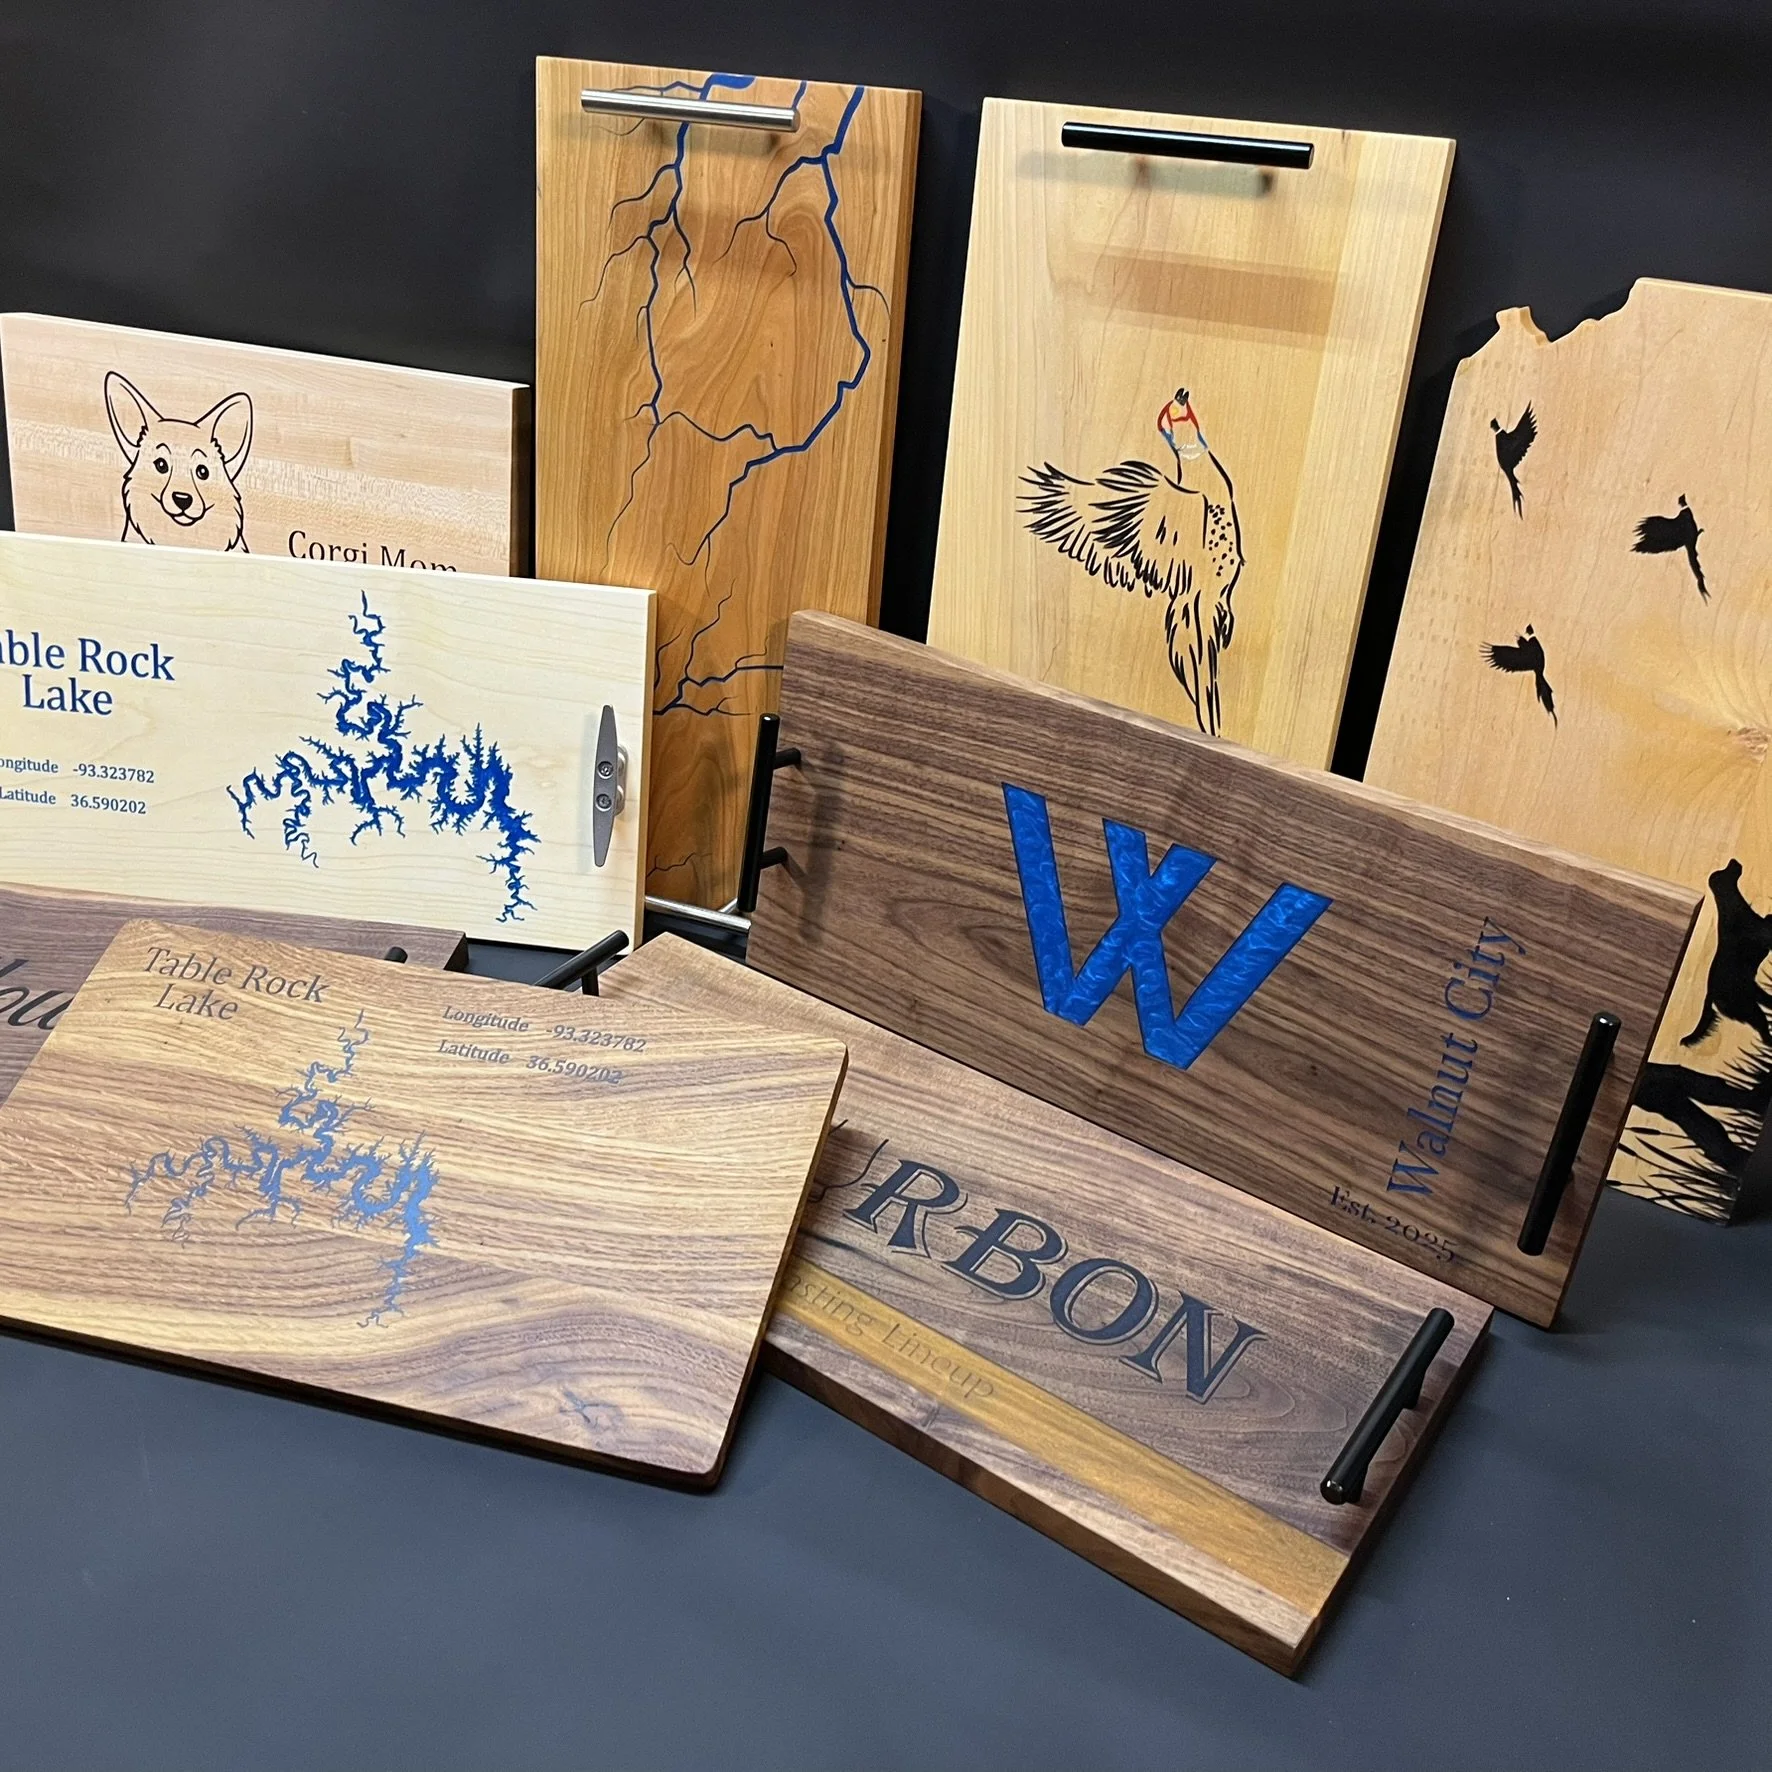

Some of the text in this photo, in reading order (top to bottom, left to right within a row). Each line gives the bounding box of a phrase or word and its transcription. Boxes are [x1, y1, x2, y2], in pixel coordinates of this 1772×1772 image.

[0, 629, 176, 681] ble Rock
[21, 673, 113, 716] Lake
[72, 764, 155, 784] -93.323782
[0, 786, 147, 815] Latitude 36.590202
[1002, 782, 1333, 1071] W
[144, 946, 332, 1004] Table Rock
[153, 982, 240, 1020] Lake
[441, 1005, 648, 1053] Longitude -93.323782
[437, 1039, 624, 1085] Latitude 36.590202
[1386, 916, 1527, 1196] Walnut City
[1384, 1215, 1459, 1264] 2025
[841, 1158, 1268, 1406] RBON
